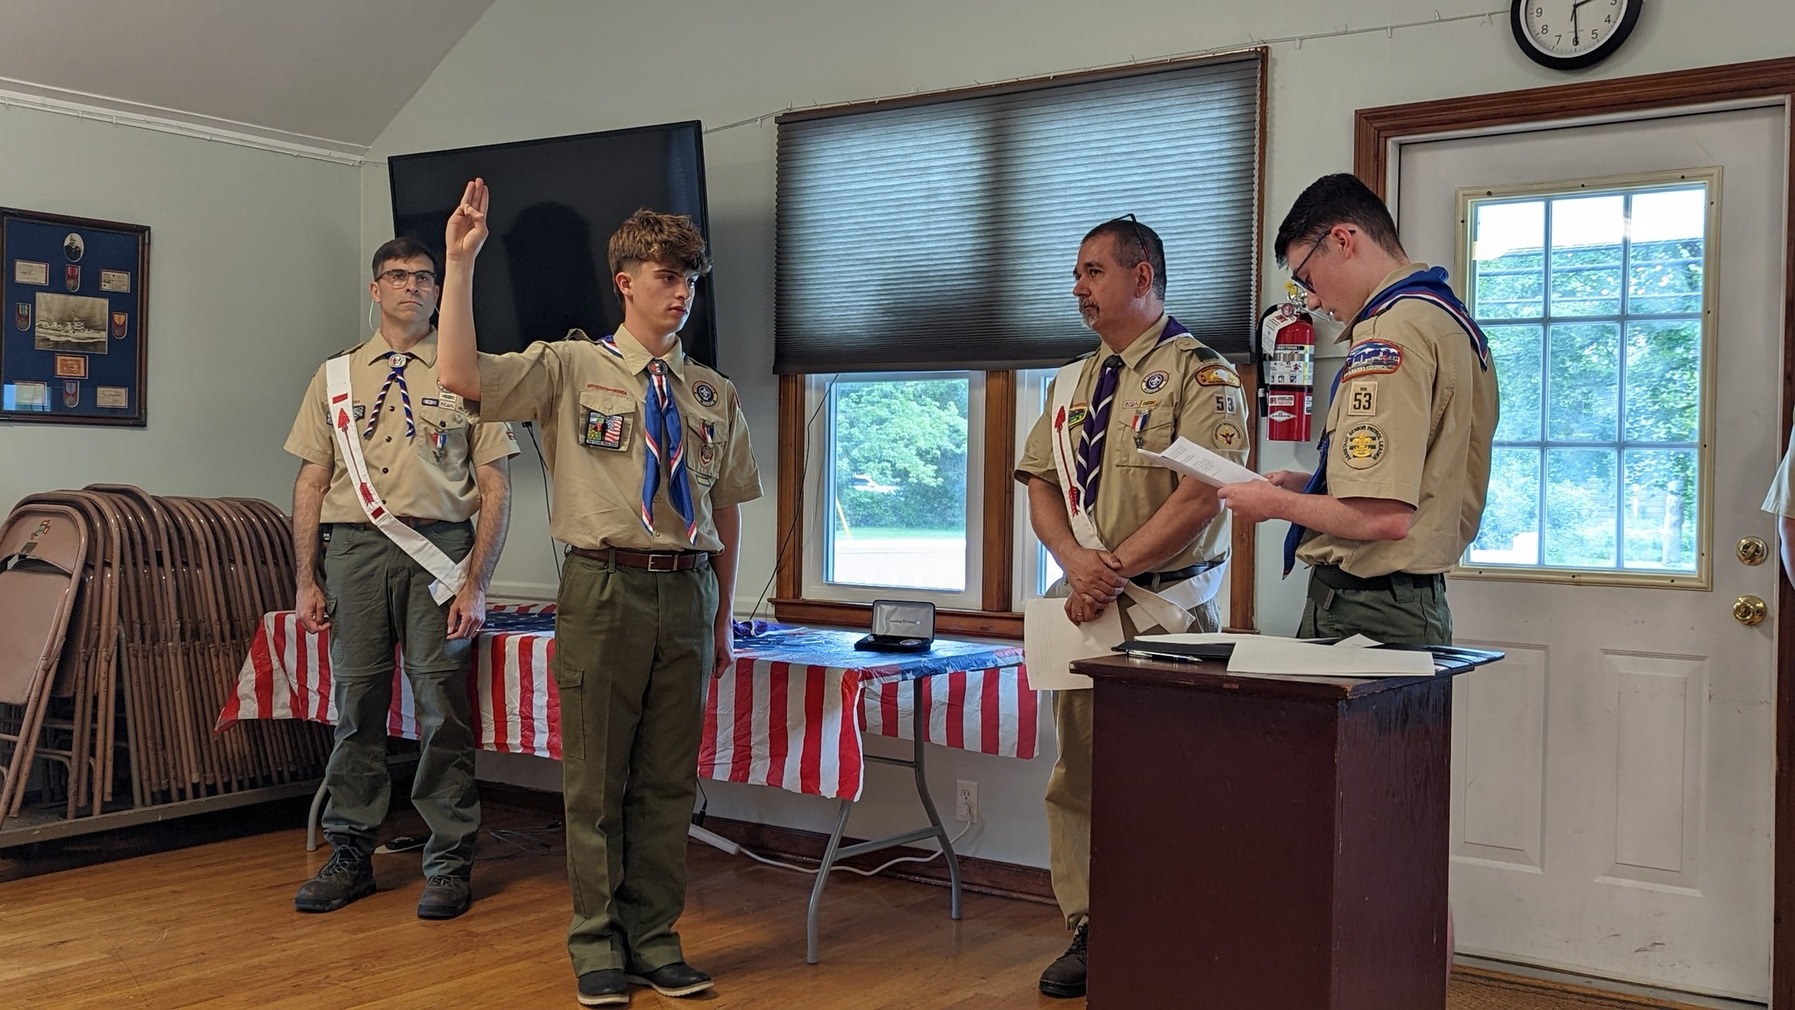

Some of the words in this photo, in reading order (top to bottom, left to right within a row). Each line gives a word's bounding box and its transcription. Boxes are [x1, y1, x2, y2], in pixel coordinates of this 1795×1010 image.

[1535, 7, 1543, 18] 9
[1604, 14, 1612, 25] 4
[1541, 24, 1549, 35] 8
[1591, 29, 1599, 40] 5
[1555, 35, 1562, 46] 7
[1572, 36, 1579, 47] 6
[1216, 396, 1234, 412] 53
[1353, 392, 1372, 410] 53
